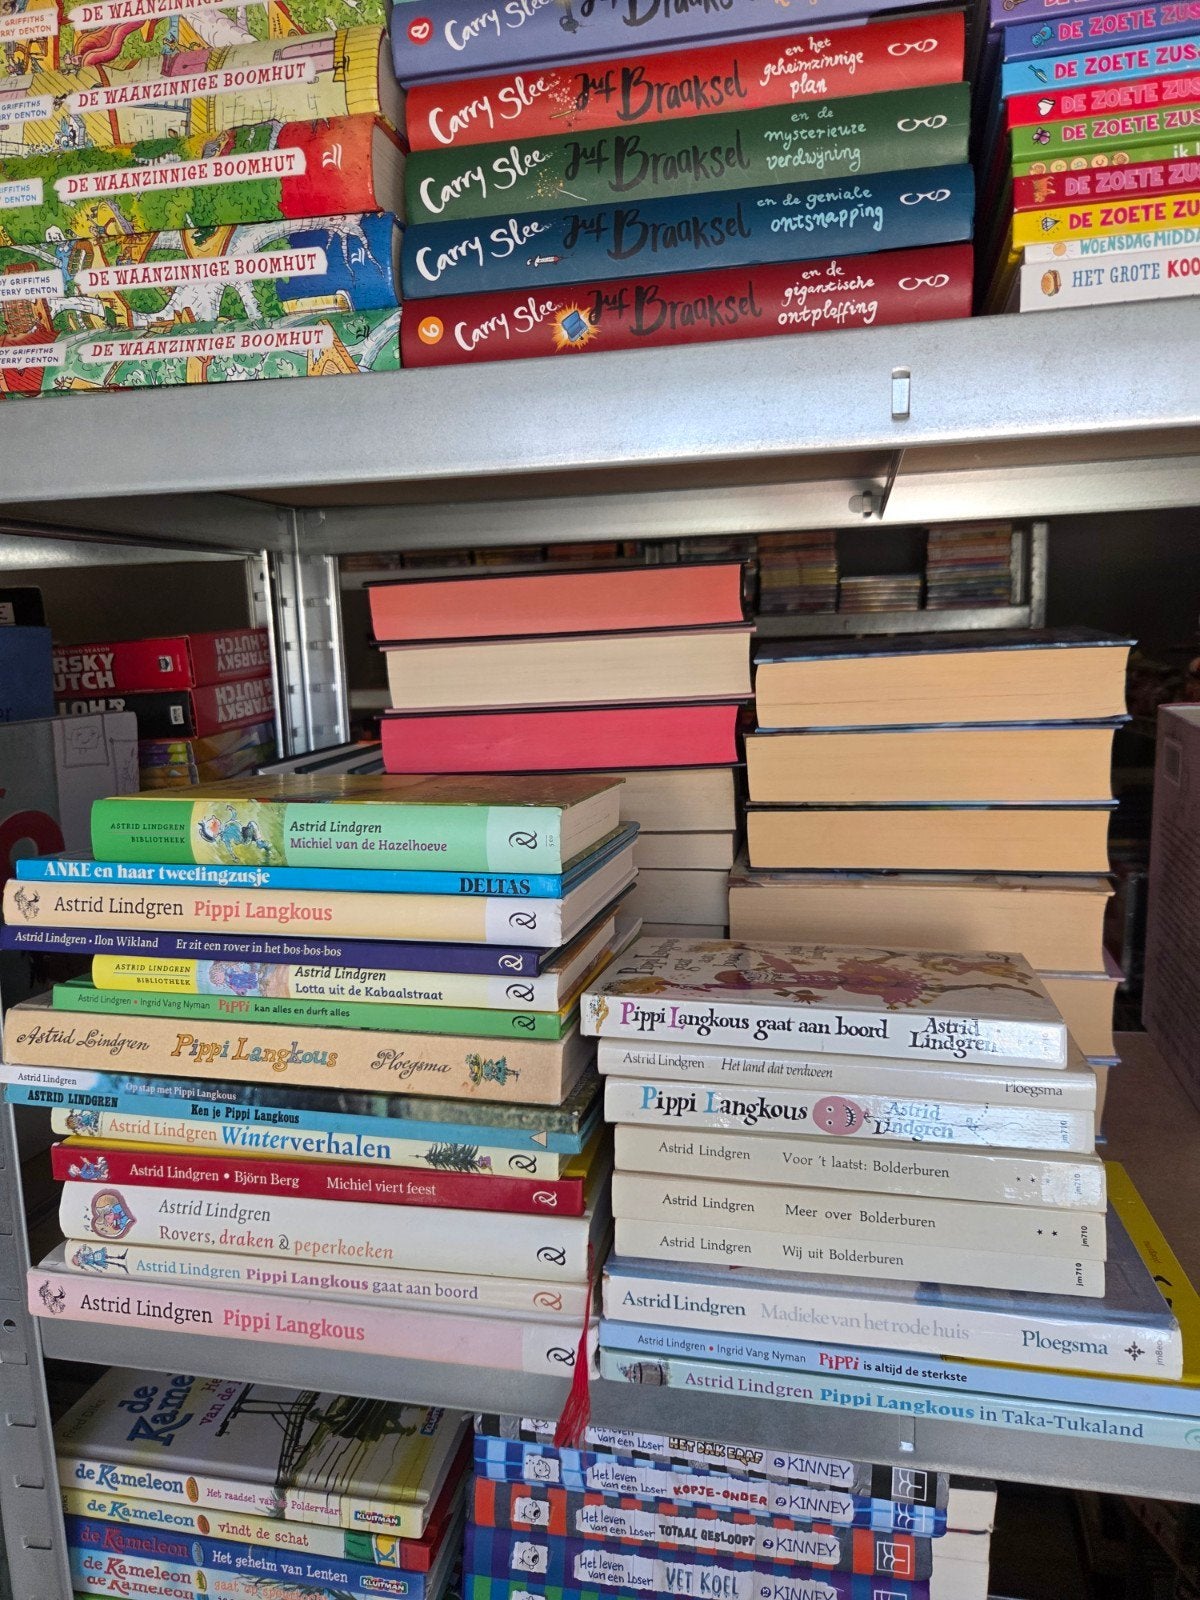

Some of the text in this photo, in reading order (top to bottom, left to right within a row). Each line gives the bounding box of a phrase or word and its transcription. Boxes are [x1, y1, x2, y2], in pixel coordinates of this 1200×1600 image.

[5, 15, 45, 26] GRIFFITHS
[19, 25, 51, 35] DENTON
[785, 36, 832, 57] en het
[760, 51, 864, 86] geheimzinnige
[1055, 51, 1149, 80] DE ZOETE
[78, 63, 306, 108] DE WAANZINNIGE BOOMHUT
[790, 72, 827, 98] plan
[429, 59, 748, 144] Carry Slee Juf Braaksel
[791, 106, 834, 122] en de
[764, 123, 867, 150] mysterieuze
[1063, 114, 1160, 142] DE ZOETE
[766, 143, 861, 171] verdwijning
[757, 186, 873, 209] en de geniale
[771, 203, 883, 232] ontsnapping
[1069, 202, 1166, 230] DE ZOETE
[10, 276, 51, 286] GRIFFITHS
[89, 254, 317, 286] DE WAANZINNIGE BOOMHUT
[802, 261, 845, 280] en de
[1072, 269, 1104, 287] HET
[1110, 262, 1160, 283] GROTE
[25, 285, 59, 296] DENTON
[782, 276, 875, 306] gigantische
[455, 313, 509, 351] Carry
[513, 297, 557, 333] Slee
[588, 288, 631, 324] Juf
[629, 281, 763, 336] Braaksel
[778, 300, 878, 326] ontploffing
[91, 329, 324, 357] DE WAANZINNIGE BOOMHUT
[110, 822, 186, 831] ASTRID LINDGREN
[131, 836, 186, 844] BIBLIOTHEEK
[290, 821, 382, 836] Astrid Lindgren
[290, 837, 447, 852] Michiel van de Hazelhoeve
[44, 861, 531, 895] ANKE en haar tweelingzusje DELTAS
[14, 931, 342, 957] Astrid Lindgren Ilon Wikland Er zit een rover in het bos-bos-bos
[295, 983, 443, 1001] Lotta uit de Kabaalstraat
[620, 1002, 889, 1041] Pippi Langkous gaat aan boord
[371, 1049, 452, 1079] Ploegsma
[18, 1073, 237, 1101] Astrid Lindgren Op stap met Pippi Langkous
[721, 1058, 1063, 1098] Het land dat verdween Ploegsma
[109, 1119, 391, 1160] Astrid Lindgren Winterverhalen
[234, 1171, 437, 1196] Björn Berg Michiel viert feest
[662, 1194, 697, 1207] Astrid
[703, 1197, 755, 1213] Lindgren
[785, 1204, 818, 1218] Meer
[824, 1210, 852, 1221] over
[860, 1211, 936, 1229] Bolderburen
[159, 1226, 215, 1245] Rovers,
[219, 1229, 274, 1249] draken
[294, 1238, 393, 1260] peperkoeken
[832, 1317, 860, 1329] van
[863, 1313, 889, 1331] het
[892, 1318, 931, 1336] rode
[933, 1320, 970, 1340] huis
[1022, 1330, 1109, 1356] Ploegsma
[980, 1406, 1144, 1438] in Taka-Tukaland
[75, 1464, 184, 1494] de Kameleon
[592, 1468, 637, 1483] Het leven
[601, 1481, 667, 1495] van een Loser
[207, 1488, 342, 1516] Het raadsel Poldervaart
[673, 1486, 767, 1506] KOPJE-ONDER
[789, 1496, 851, 1515] KINNEY
[356, 1511, 399, 1526] KLUITMAN
[218, 1523, 309, 1547] vindt de schat
[659, 1524, 756, 1547] TOTAAL GESLOOPT
[213, 1551, 348, 1584] Het geheim van Lenten
[665, 1567, 738, 1595] VET KOEL
[362, 1578, 405, 1592] KLUITMAN
